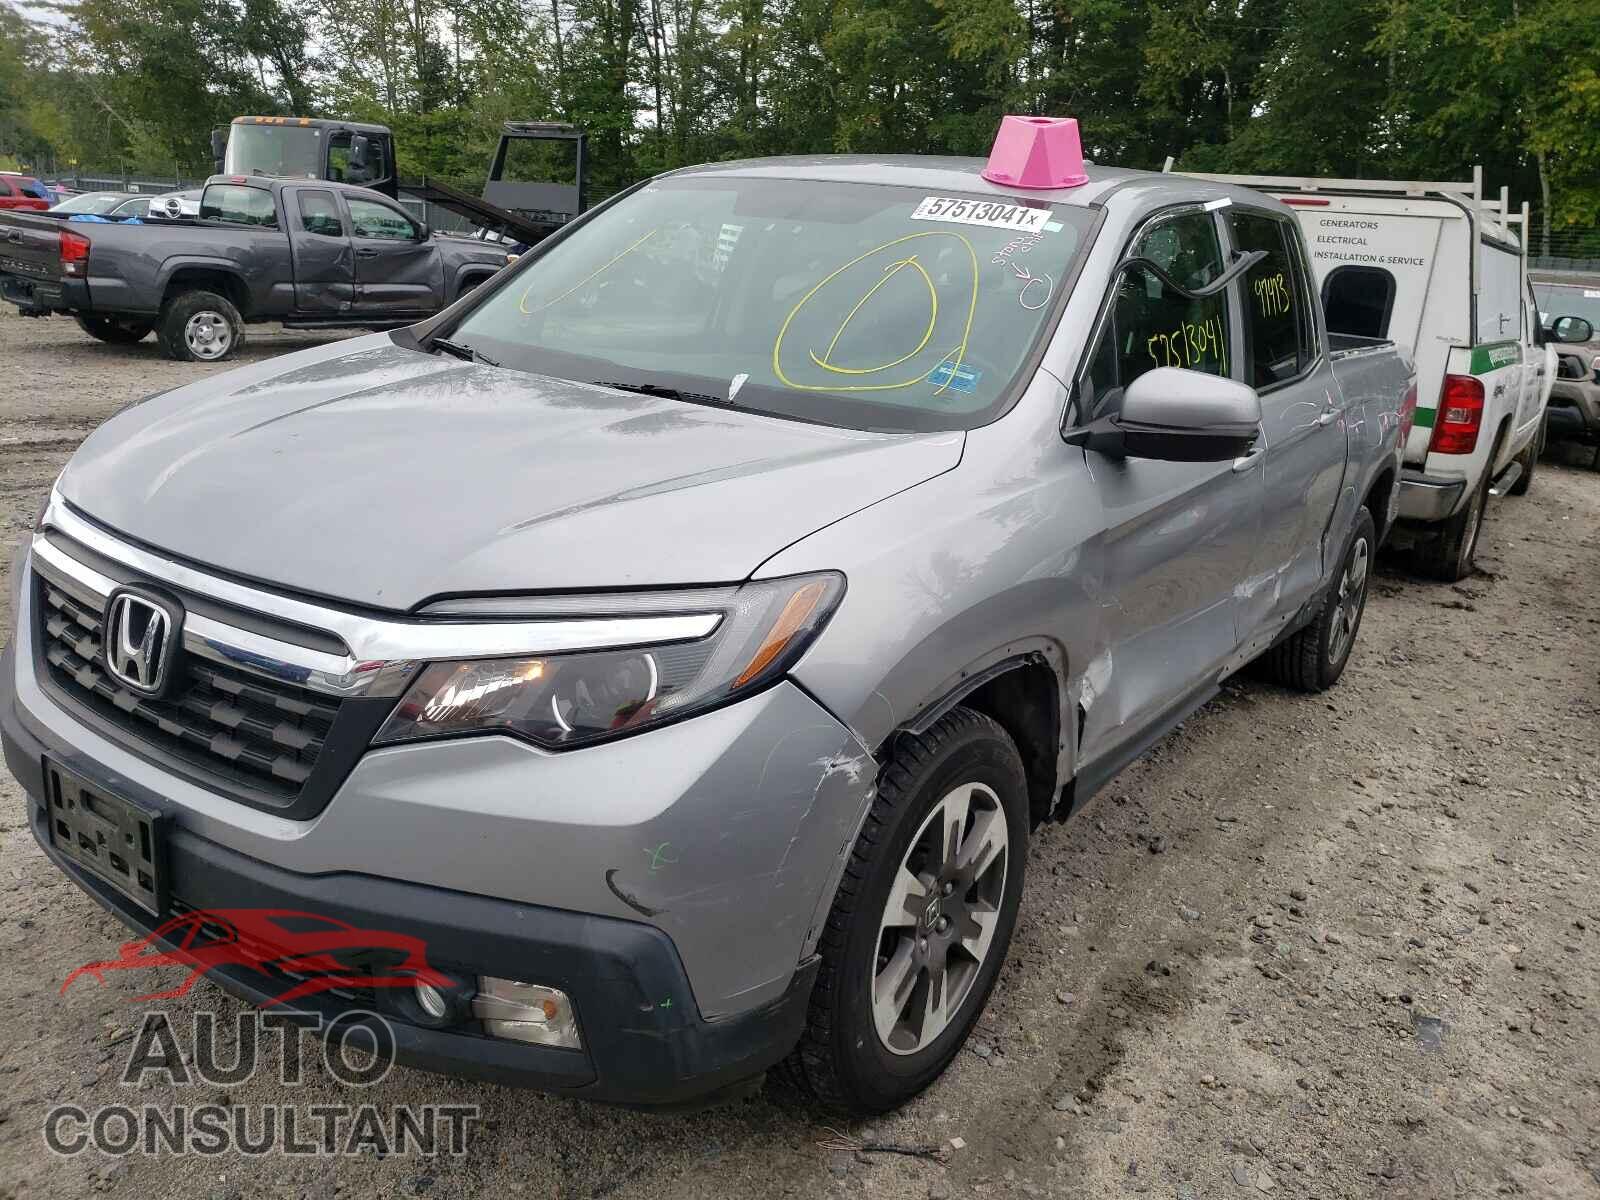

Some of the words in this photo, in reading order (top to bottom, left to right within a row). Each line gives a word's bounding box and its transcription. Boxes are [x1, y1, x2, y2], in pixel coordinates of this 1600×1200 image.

[1319, 219, 1379, 230] GENERATORS
[1316, 235, 1369, 246] ELECTRICAL
[1314, 251, 1378, 264] INSTALLATION
[1378, 255, 1386, 263] &
[1387, 256, 1425, 266] SERVICE
